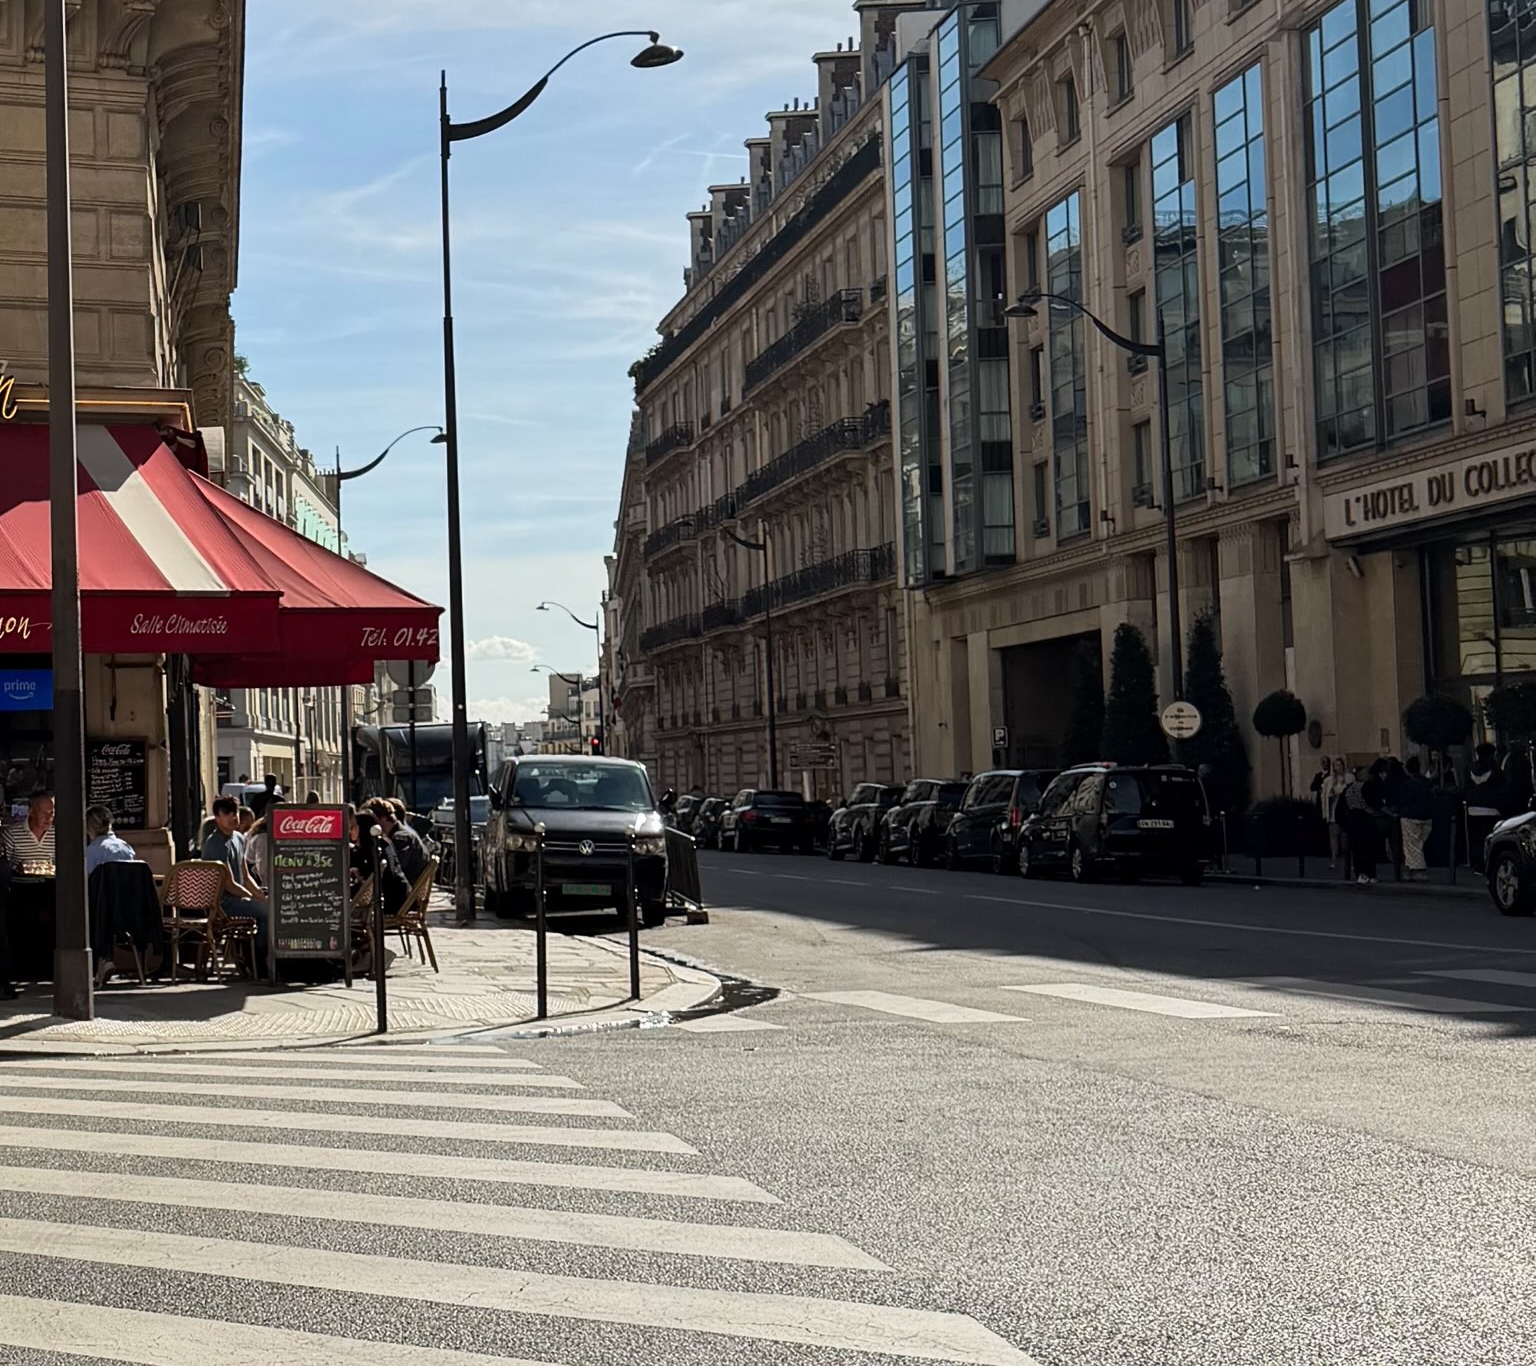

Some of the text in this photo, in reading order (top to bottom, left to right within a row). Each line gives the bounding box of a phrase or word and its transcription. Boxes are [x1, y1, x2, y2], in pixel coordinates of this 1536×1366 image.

[1344, 482, 1420, 528] L'HOTEL
[1427, 471, 1455, 507] DU
[130, 613, 229, 634] Salle Climatisée
[360, 627, 387, 647] Tél:
[3, 679, 37, 693] prime
[280, 815, 336, 834] Coca-Cola
